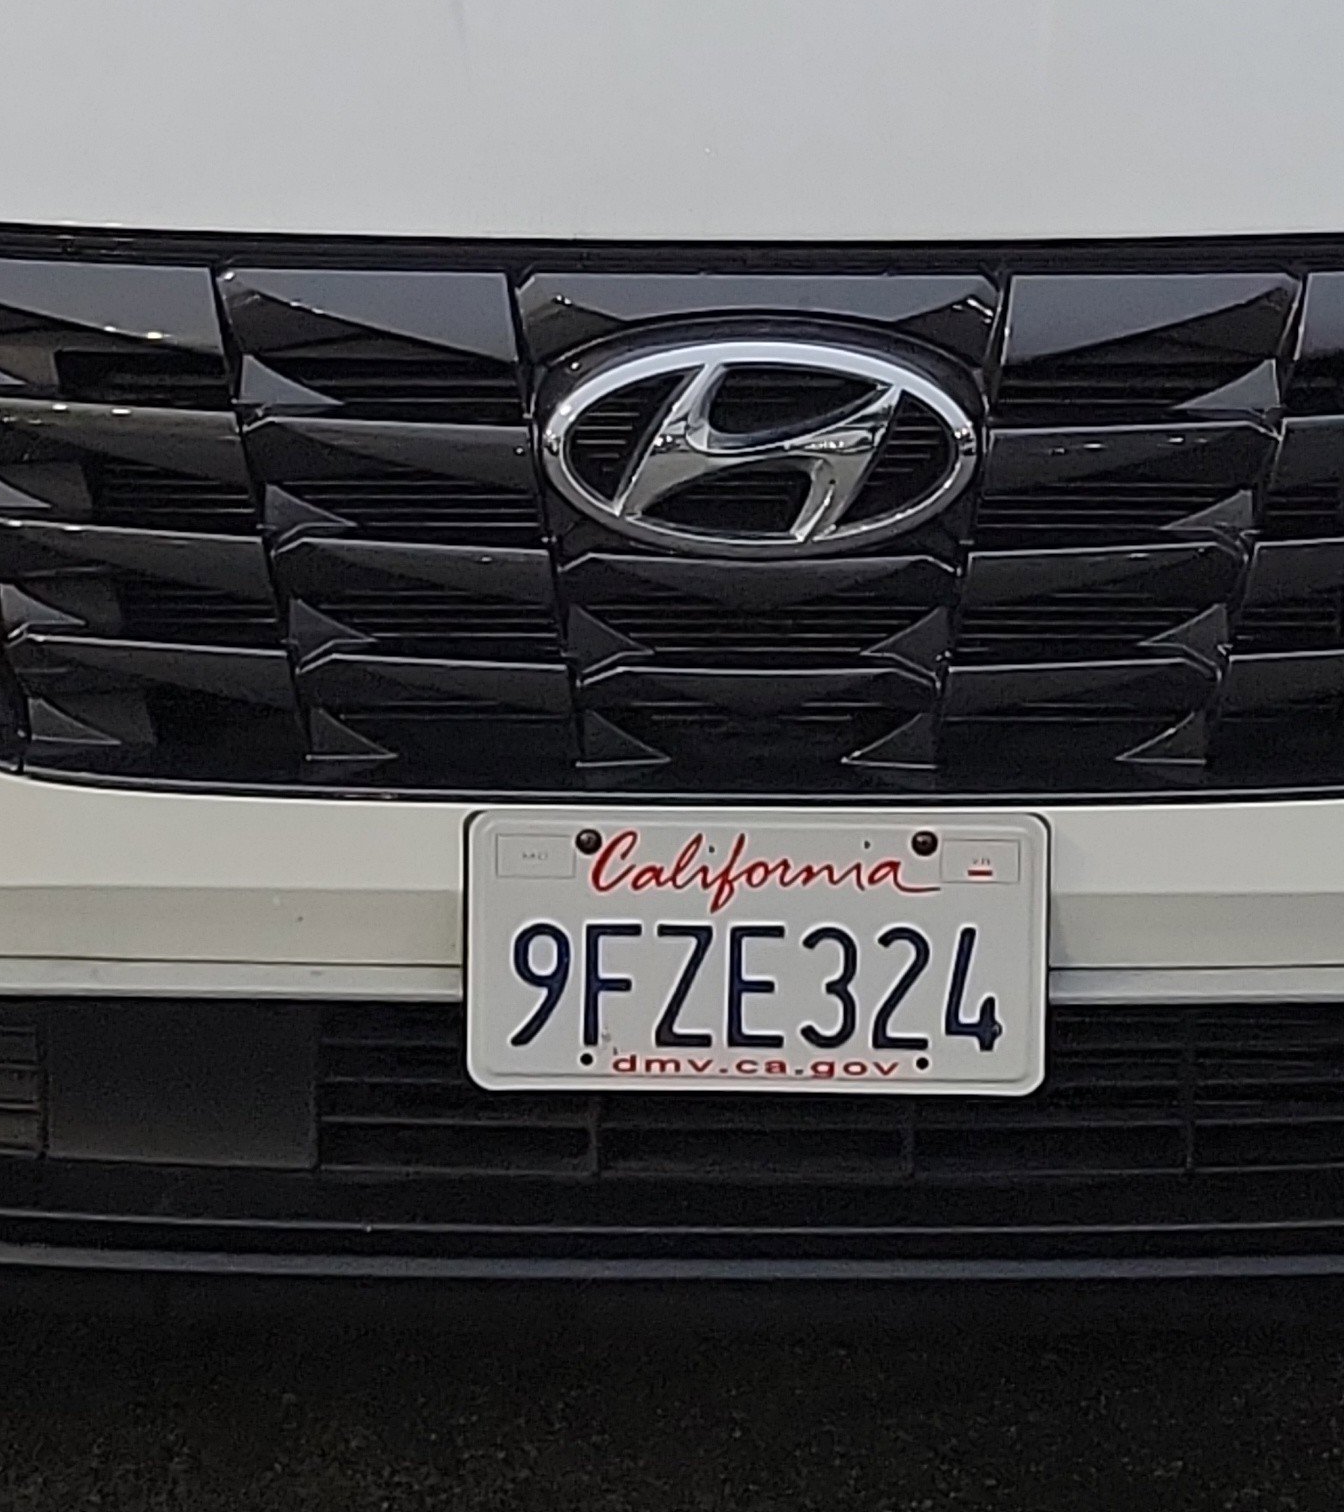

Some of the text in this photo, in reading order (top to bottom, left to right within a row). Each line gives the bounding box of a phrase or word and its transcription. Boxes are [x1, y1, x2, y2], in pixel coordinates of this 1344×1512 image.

[591, 830, 941, 914] California
[510, 923, 1003, 1051] 9FZE324
[612, 1052, 900, 1078] dmv.ca.gov
